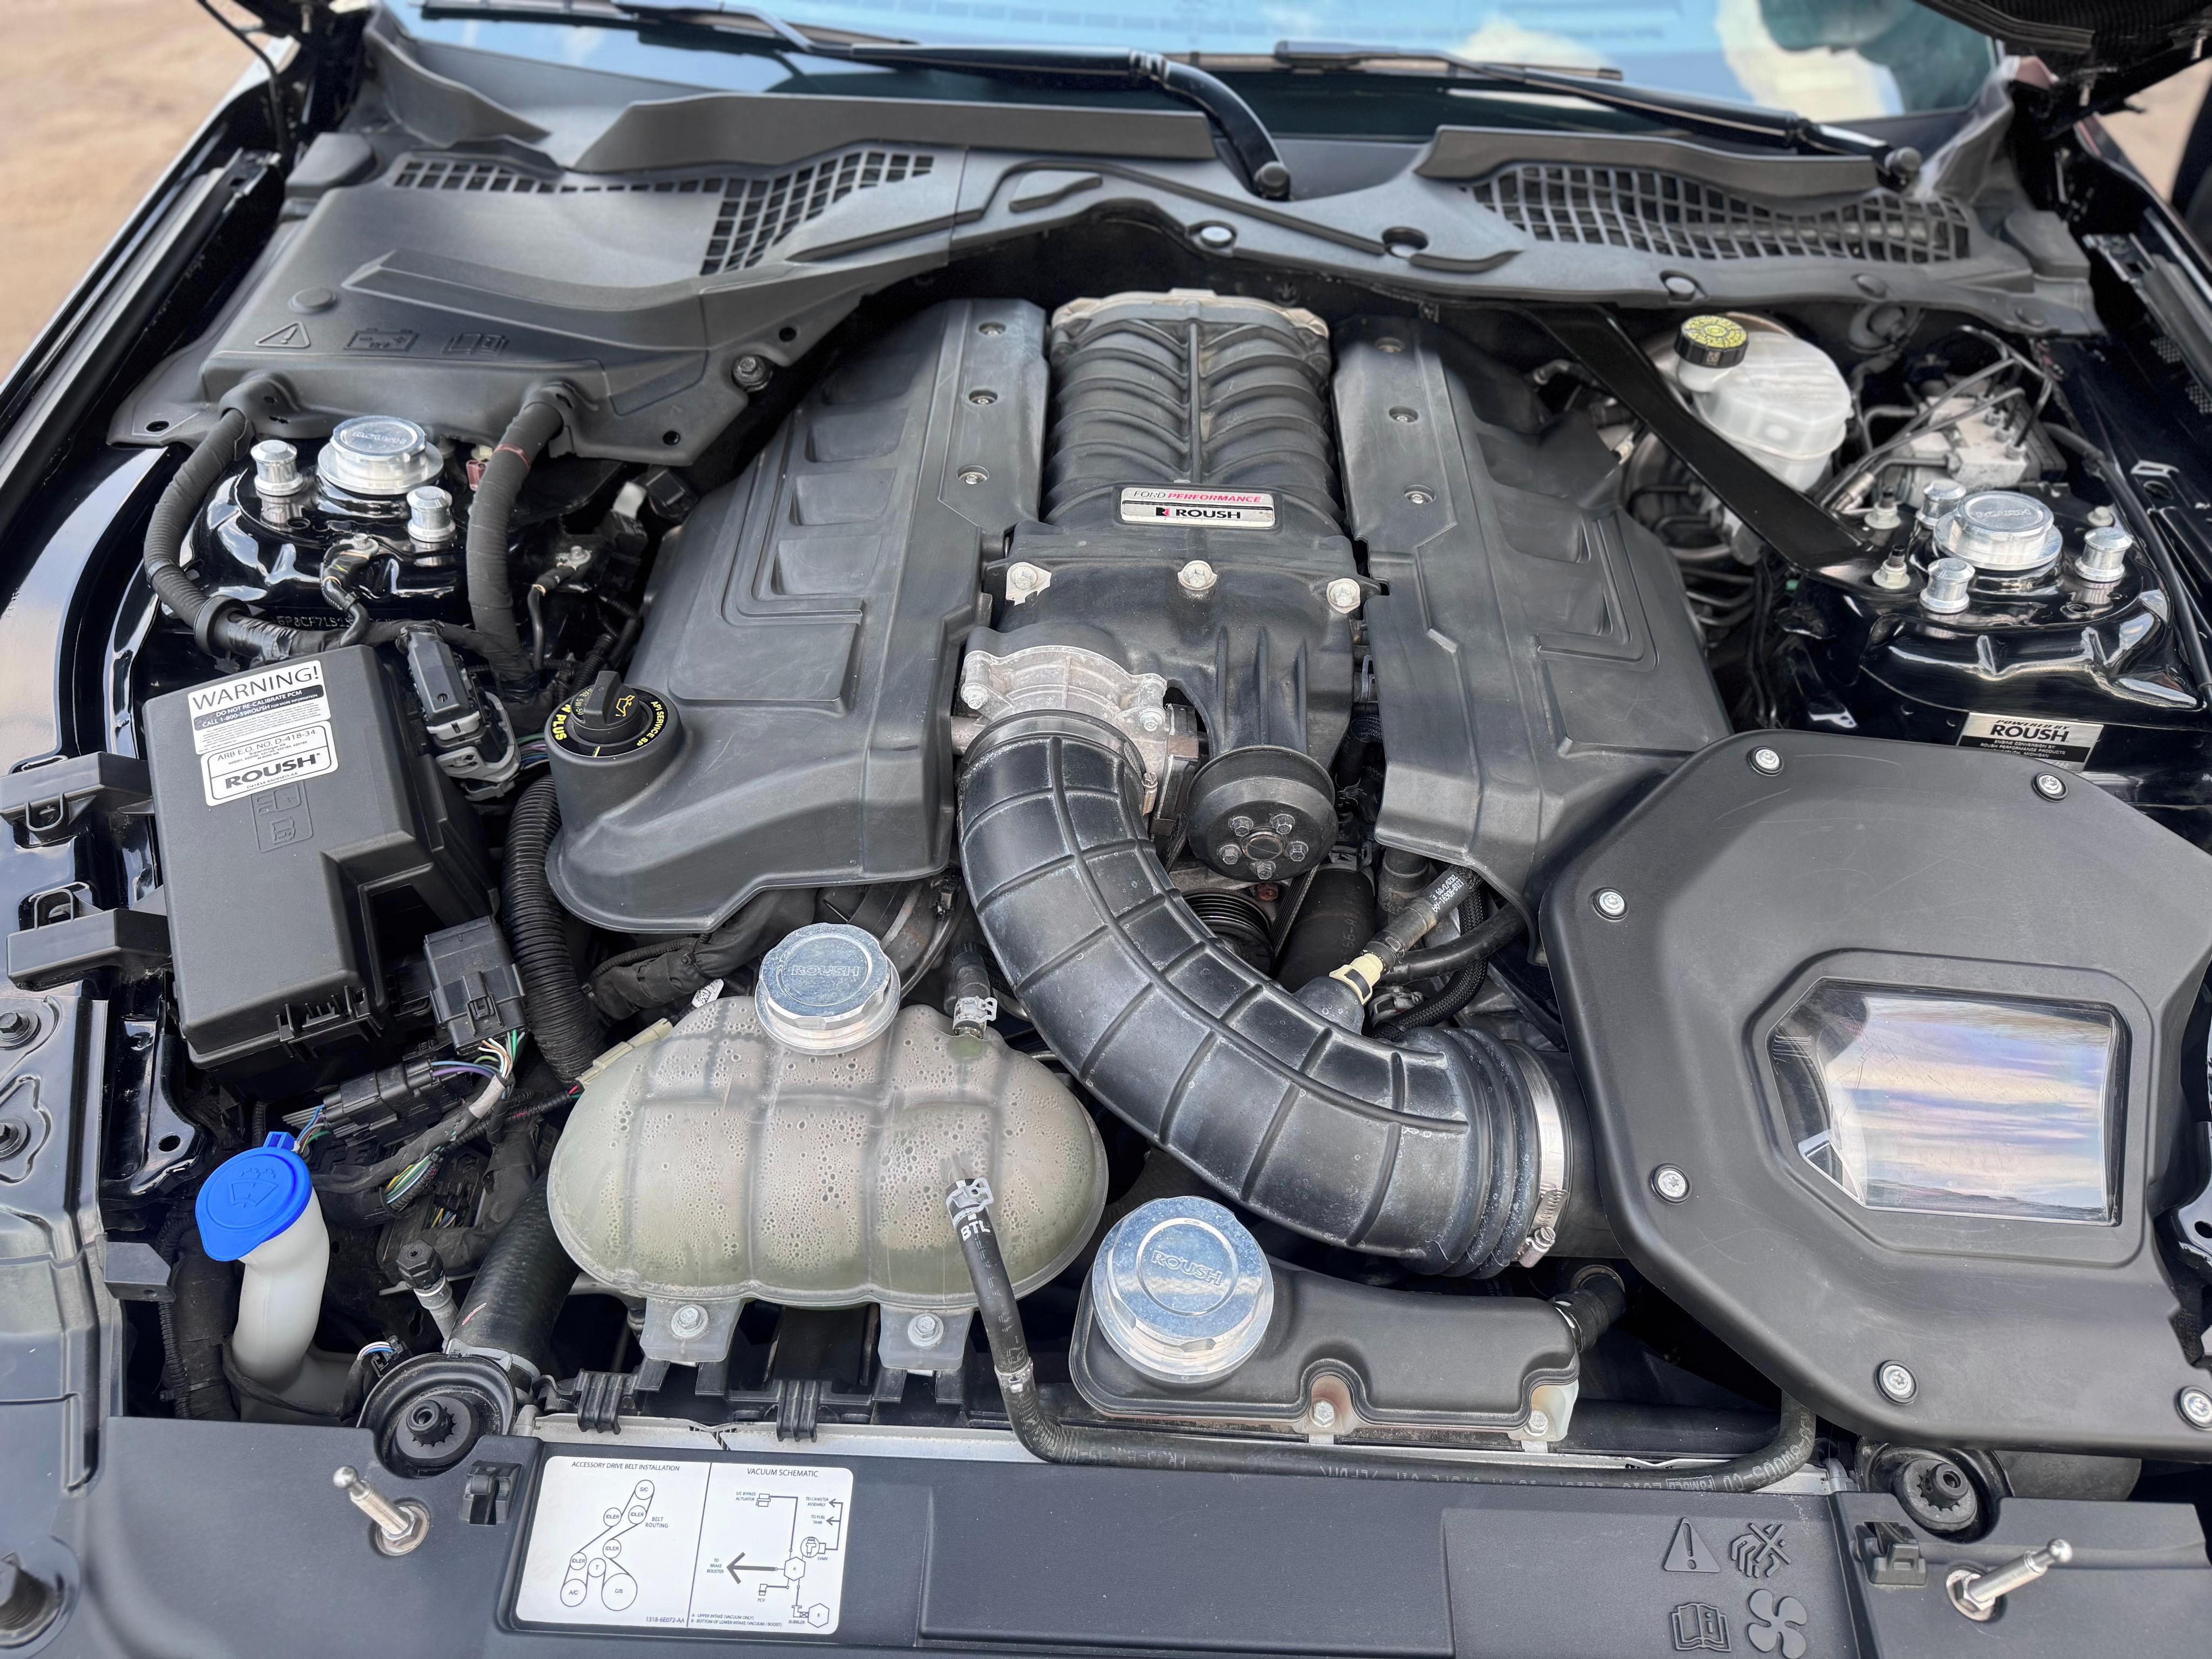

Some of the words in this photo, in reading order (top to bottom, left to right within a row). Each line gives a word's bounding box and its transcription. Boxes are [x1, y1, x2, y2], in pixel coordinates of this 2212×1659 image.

[1134, 490, 1165, 498] FORD
[1168, 493, 1262, 503] PERFORMANCE
[1176, 509, 1240, 519] ROUSH
[1973, 508, 2032, 518] ROUSH
[193, 666, 319, 710] WARNING!
[227, 706, 241, 714] NOT
[242, 694, 287, 709] RE-CALIBRATE
[287, 690, 302, 698] PCM
[561, 704, 571, 713] N
[575, 698, 584, 716] 5W-50
[650, 701, 663, 711] API
[202, 719, 219, 729] CALL
[220, 704, 270, 723] 1-800-59ROUSH
[1995, 719, 2053, 729] POWERED
[552, 714, 567, 740] PLUS
[646, 711, 665, 738] SERVICE
[1990, 724, 2069, 742] ROUSH
[218, 752, 235, 761] ARB
[238, 746, 254, 755] E.O.
[257, 741, 273, 750] NO.
[275, 729, 315, 743] D-418-34
[636, 737, 649, 746] SP
[1999, 745, 2037, 753] PERFORMANCE
[791, 965, 860, 976] ROUSH
[960, 1219, 990, 1241] BTL
[1151, 1250, 1223, 1286] ROUSH
[779, 1469, 819, 1478] SCHEMATIC
